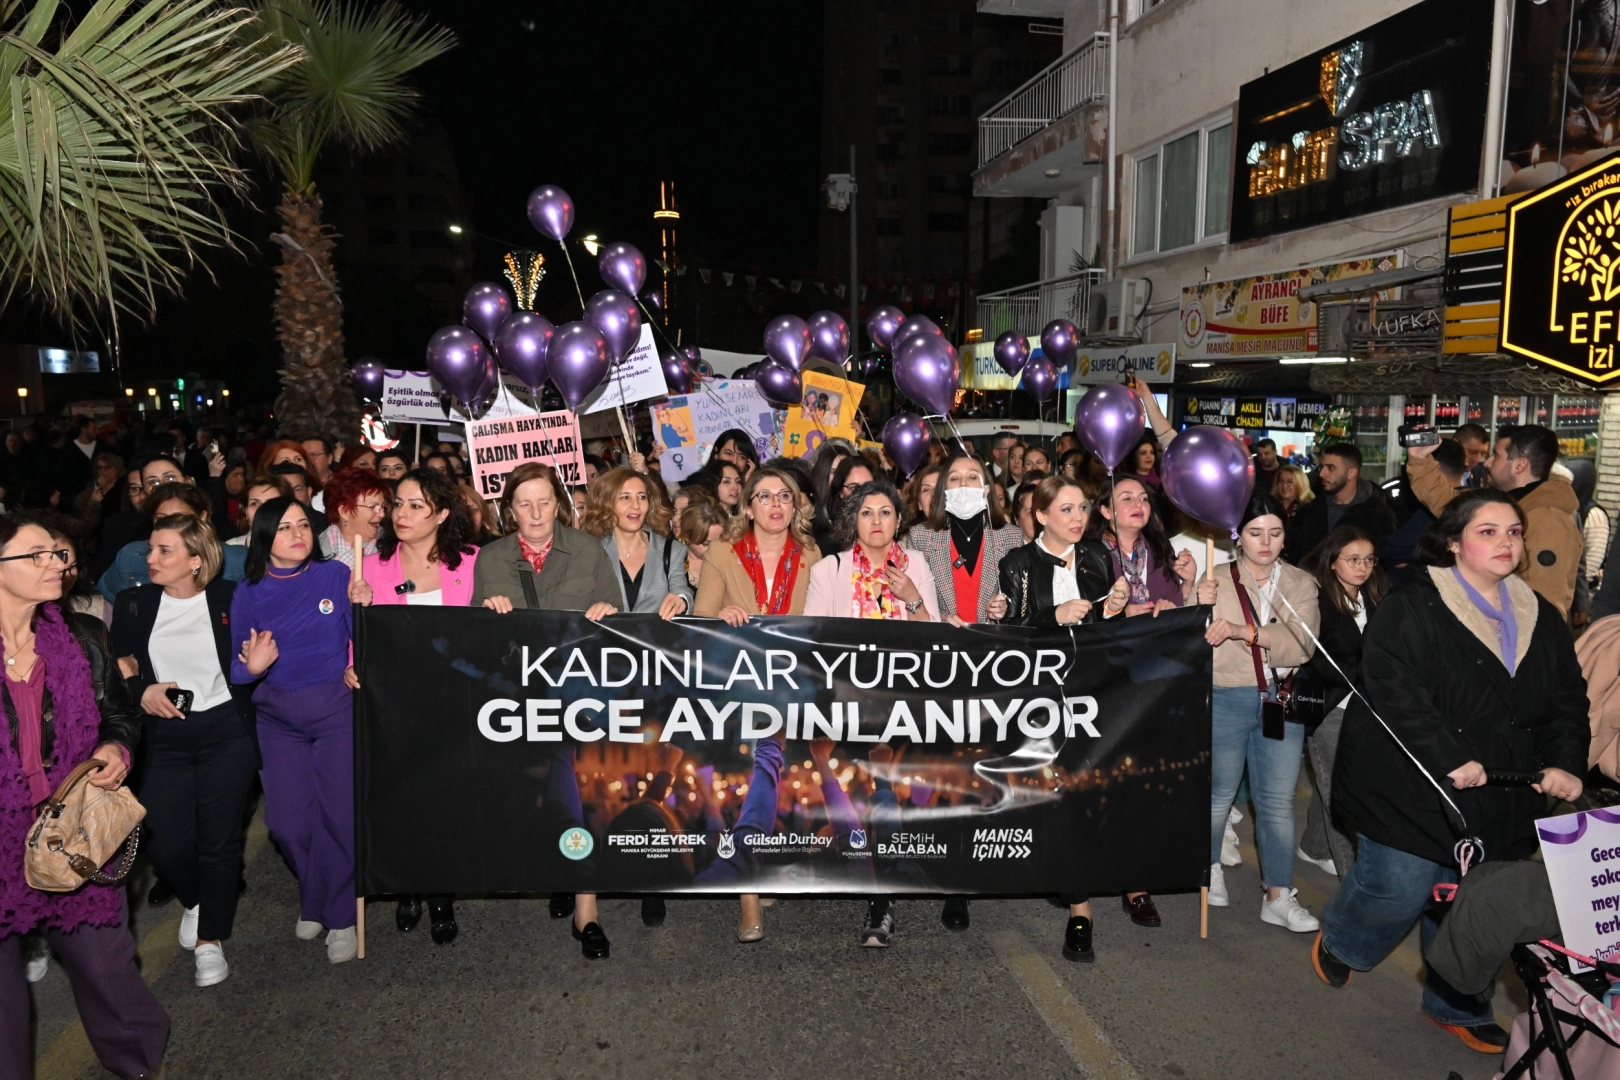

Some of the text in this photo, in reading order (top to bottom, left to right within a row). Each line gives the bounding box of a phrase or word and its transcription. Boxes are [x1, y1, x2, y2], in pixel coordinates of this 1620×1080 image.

[1338, 90, 1441, 171] SPA
[1260, 304, 1289, 324] BÜFE
[1371, 309, 1441, 337] YUFKA
[1570, 310, 1620, 344] EF
[1206, 339, 1235, 354] MANİSA
[1264, 336, 1302, 351] MACUNU
[1375, 360, 1417, 375] SÜT
[388, 387, 413, 397] Eşitlik
[387, 396, 424, 407] özgürlük
[1241, 403, 1262, 413] AKILLI
[1203, 415, 1228, 426] SORGULA
[1236, 414, 1264, 427] CİHAZINI
[471, 421, 515, 440] ÇALIŞMA
[475, 435, 578, 465] KADIN HAKLARI
[520, 644, 1067, 691] KADINLAR YÜRÜYOR
[477, 696, 1102, 744] GECE AYDINLANIYOR
[651, 834, 706, 846] ZEYREK
[789, 832, 833, 848] Durbay
[877, 843, 947, 855] BALABAN
[1591, 895, 1620, 911] mey
